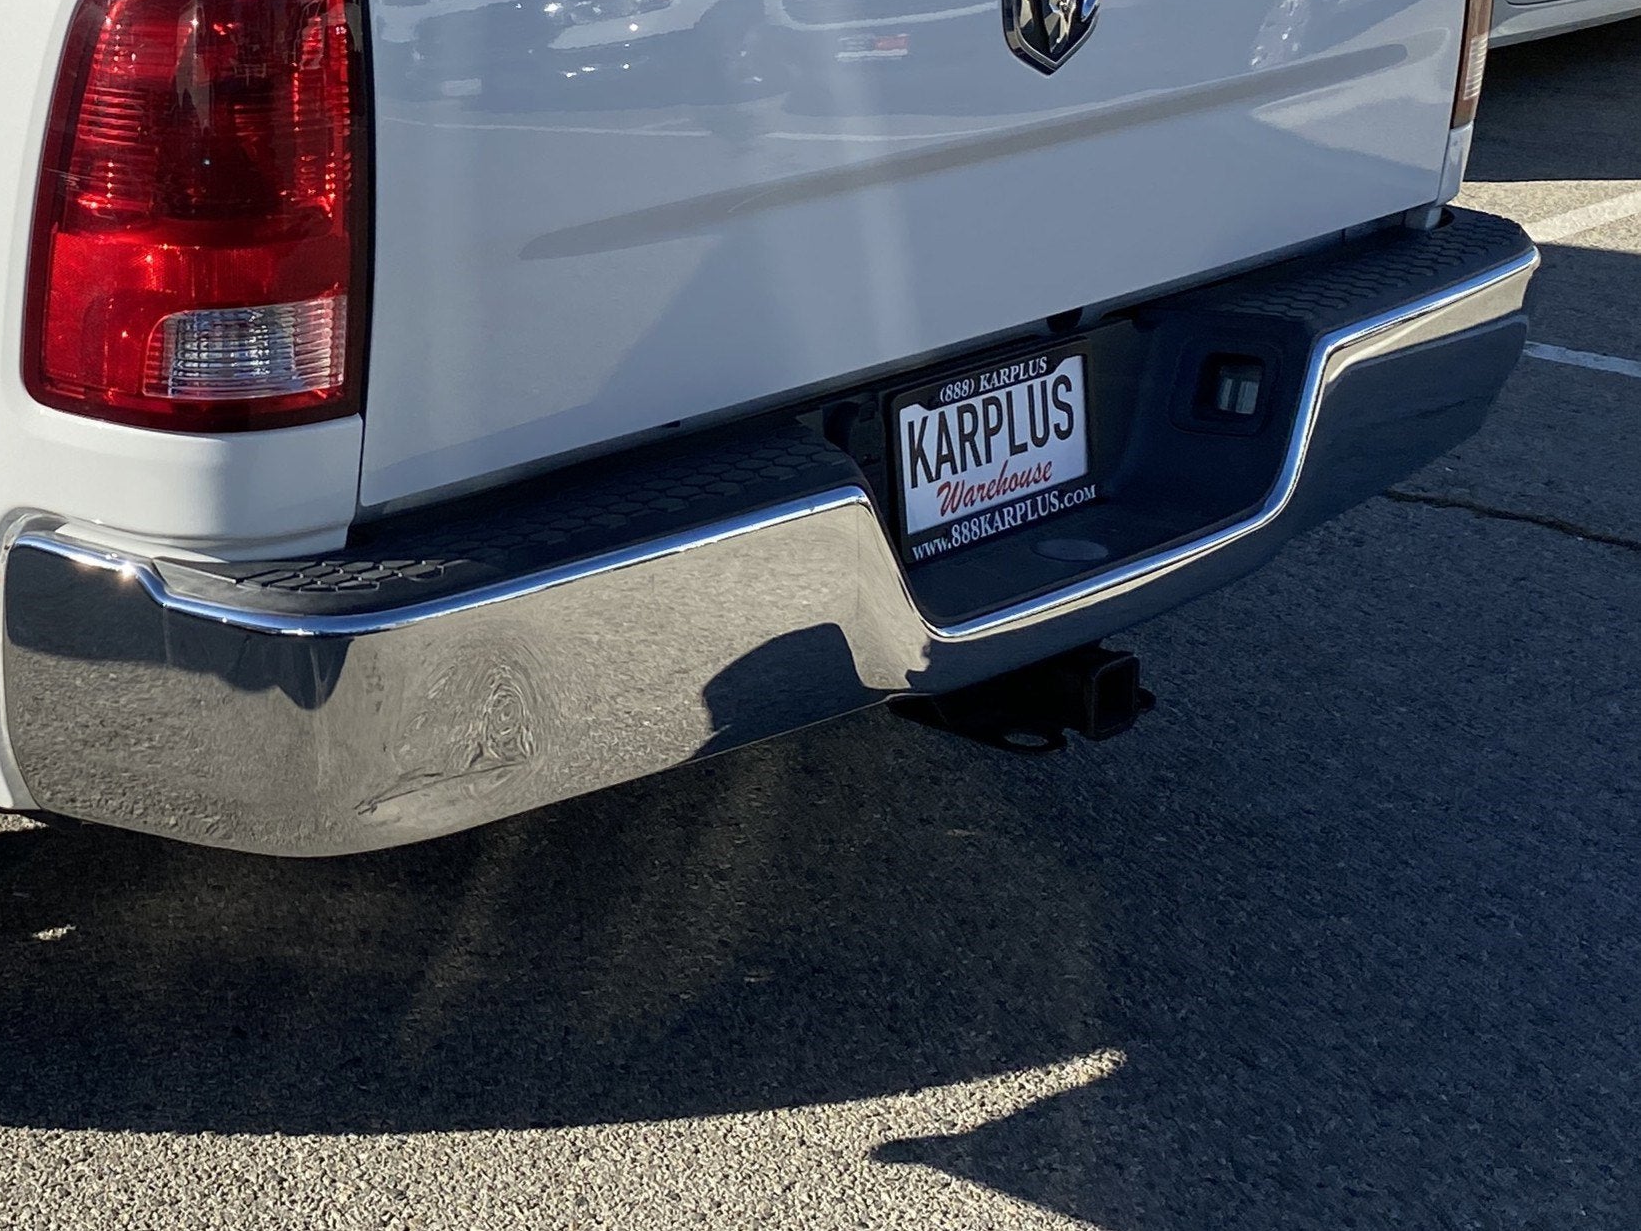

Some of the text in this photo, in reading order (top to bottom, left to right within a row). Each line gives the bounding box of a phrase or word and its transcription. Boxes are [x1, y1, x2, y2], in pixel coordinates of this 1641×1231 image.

[939, 356, 1048, 403] (888) KARPLUS
[907, 374, 1075, 489] KARPLUS
[936, 459, 1053, 518] Warehouse
